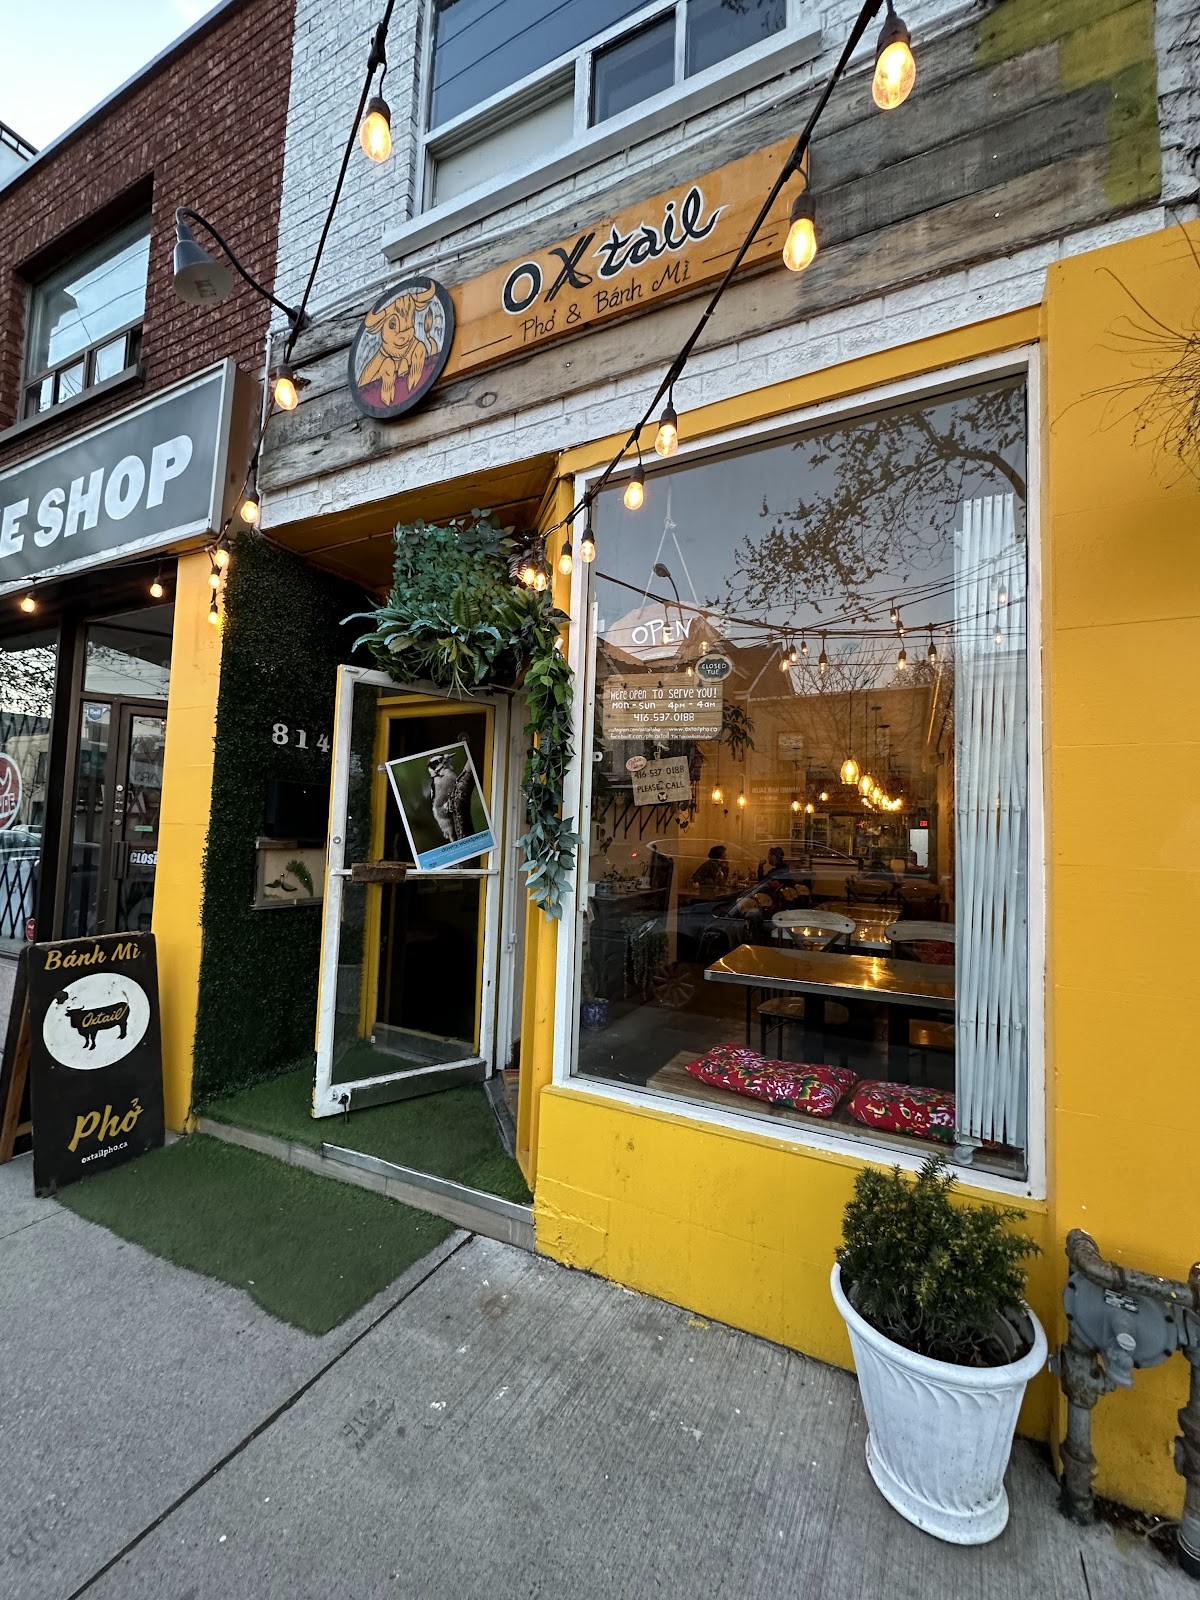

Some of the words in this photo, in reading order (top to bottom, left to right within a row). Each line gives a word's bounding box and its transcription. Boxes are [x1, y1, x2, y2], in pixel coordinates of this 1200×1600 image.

[567, 303, 582, 324] &
[592, 278, 643, 314] Bánh
[34, 434, 193, 548] SHOP
[631, 618, 693, 646] OPEN
[652, 689, 663, 699] TO
[696, 687, 717, 698] YOU!
[633, 712, 695, 722] 416.537.0188
[271, 723, 331, 753] 814
[634, 770, 647, 779] 416
[649, 768, 662, 777] 537
[666, 765, 685, 775] 0188
[637, 783, 663, 793] PLEASE
[665, 781, 685, 790] CALL
[44, 944, 107, 971] Bánh
[111, 942, 141, 962] Mì
[82, 1006, 126, 1028] Oxtail
[81, 1141, 129, 1164] oxtailpho.ca
